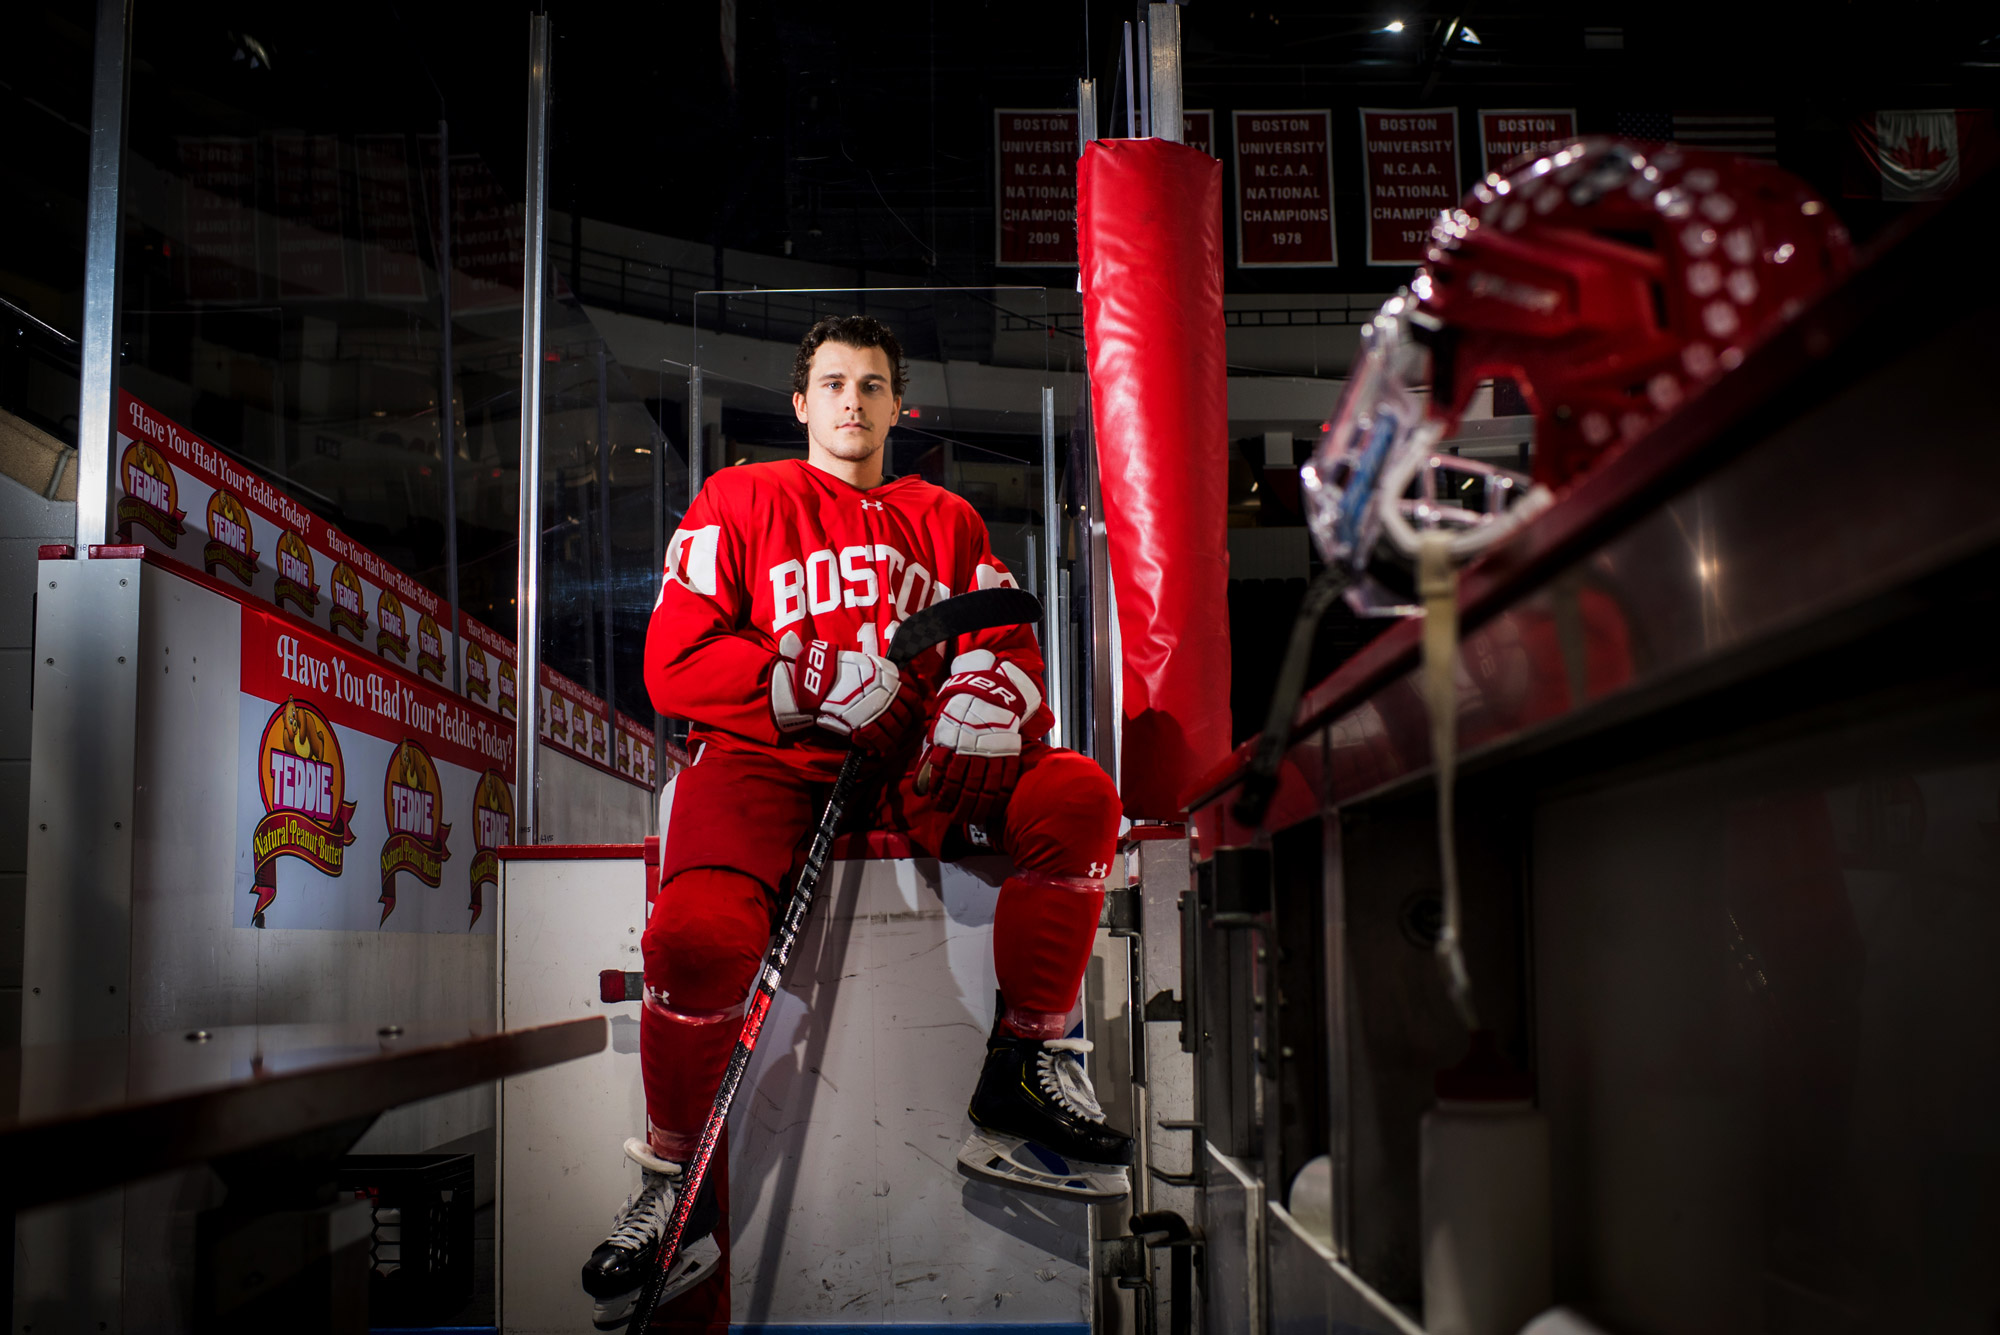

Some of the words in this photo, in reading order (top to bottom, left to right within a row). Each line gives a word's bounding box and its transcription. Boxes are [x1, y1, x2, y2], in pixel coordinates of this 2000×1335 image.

[1013, 118, 1069, 132] BOSTON
[1251, 119, 1310, 133] BOSTON
[1379, 118, 1437, 132] BOSTON
[1498, 119, 1556, 132] BOSTON
[1002, 140, 1077, 154] UNIVERSIT
[1240, 141, 1325, 155] UNIVERSITY
[1368, 140, 1452, 154] UNIVERSITY
[1014, 163, 1070, 177] N.C.A.A.
[1254, 163, 1314, 177] N.C.A.A.
[1383, 162, 1442, 176] N.C.A.A.
[1246, 186, 1321, 200] NATIONAL
[1375, 184, 1450, 198] NATIONAL
[1242, 208, 1329, 222] CHAMPIONS
[1028, 232, 1060, 245] 2009
[1272, 232, 1302, 246] 1978
[129, 401, 164, 443] Have
[166, 424, 190, 460] You
[191, 442, 217, 476] Had
[218, 458, 245, 492] Your
[245, 475, 278, 513] Teddie
[279, 495, 311, 536] Today?
[128, 464, 170, 513] TEDDIE
[212, 511, 247, 557] TEDDIE
[281, 549, 309, 590] TEDDIE
[327, 528, 348, 557] Have
[348, 541, 363, 568] You
[363, 552, 379, 577] Had
[380, 562, 396, 587] Your
[396, 573, 417, 601] Teddie
[417, 587, 438, 616] Today?
[334, 580, 359, 616] TEDDIE
[276, 634, 329, 693] Have
[332, 656, 365, 708] You
[366, 672, 401, 721] Had
[401, 687, 435, 734] Your
[436, 701, 477, 751] Teddie
[477, 720, 513, 772] Today?
[271, 750, 333, 815] TEDDIE
[392, 783, 434, 836] TEDDIE
[478, 807, 510, 849] TEDDIE
[254, 816, 289, 862] Natural
[289, 819, 317, 856] Peanut
[318, 835, 342, 866] Butter
[381, 838, 404, 876] Natural
